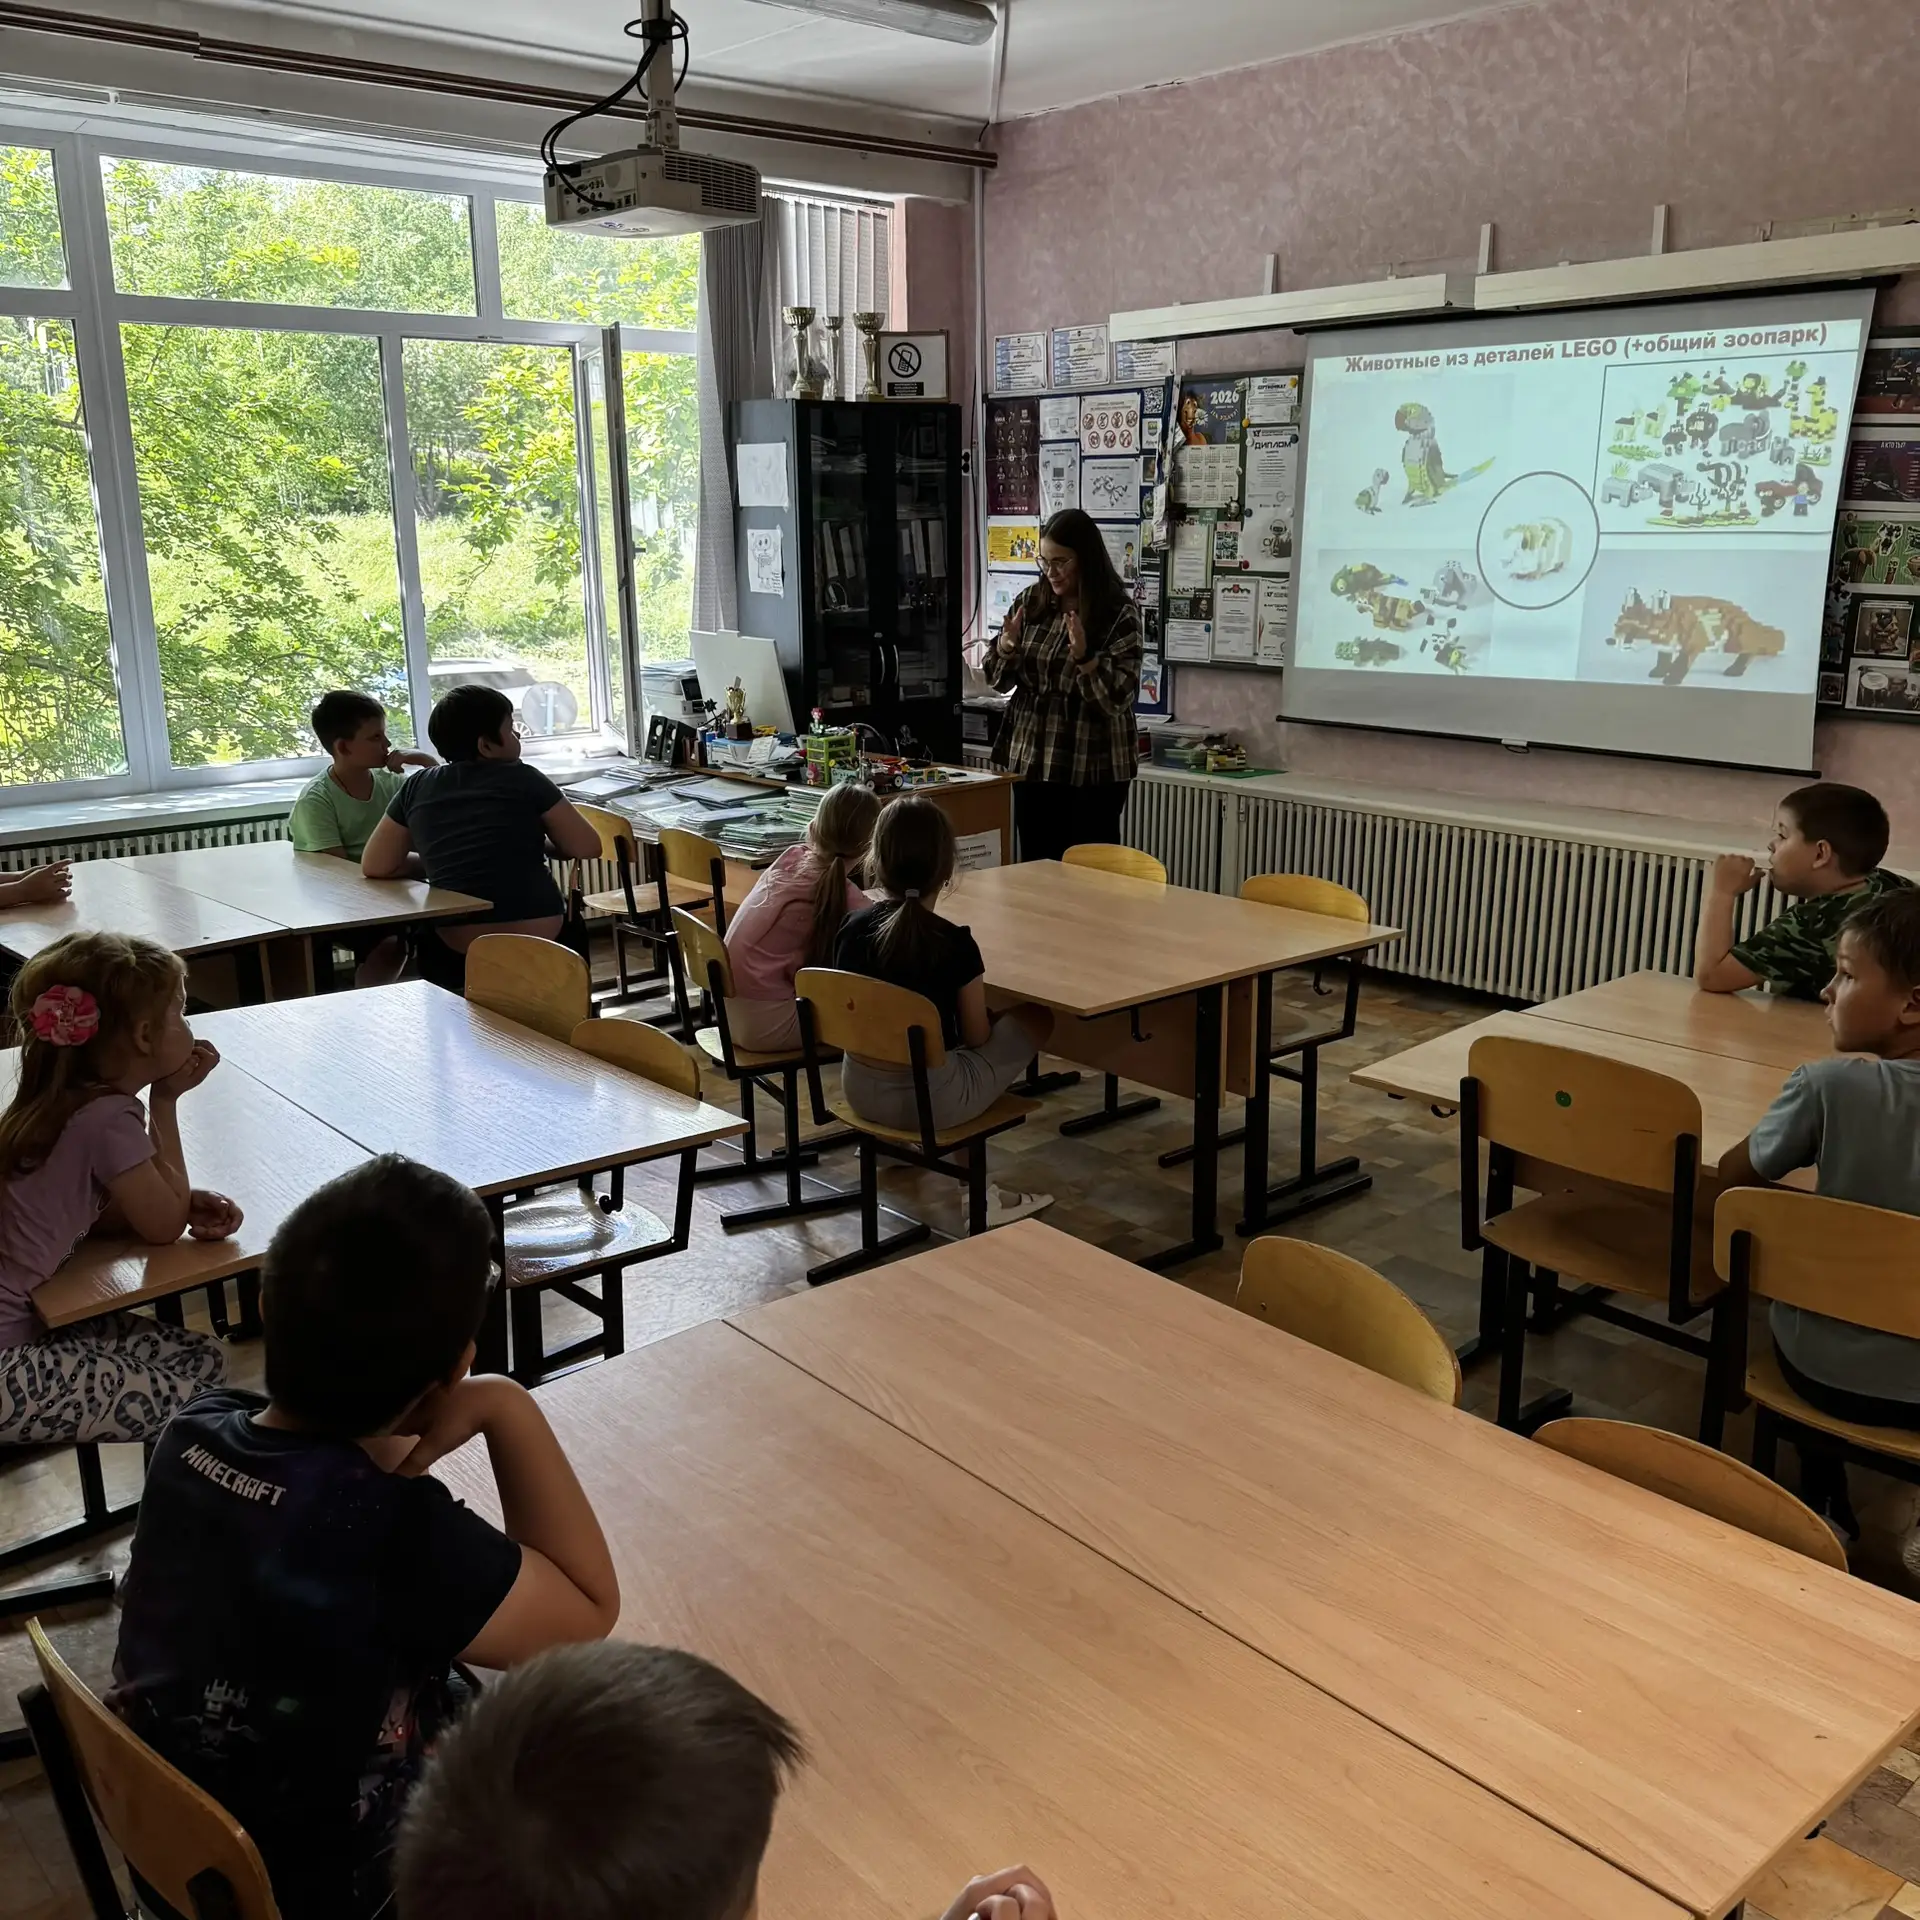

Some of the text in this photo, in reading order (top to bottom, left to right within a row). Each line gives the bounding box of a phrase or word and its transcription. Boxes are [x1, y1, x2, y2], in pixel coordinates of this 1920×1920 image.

[1345, 322, 1828, 373] Животные из деталей LEGO (+общий зоопарк)
[1210, 391, 1239, 405] 2026
[1254, 441, 1291, 450] ДИПЛОМ
[180, 1443, 287, 1506] MINECRAFT
